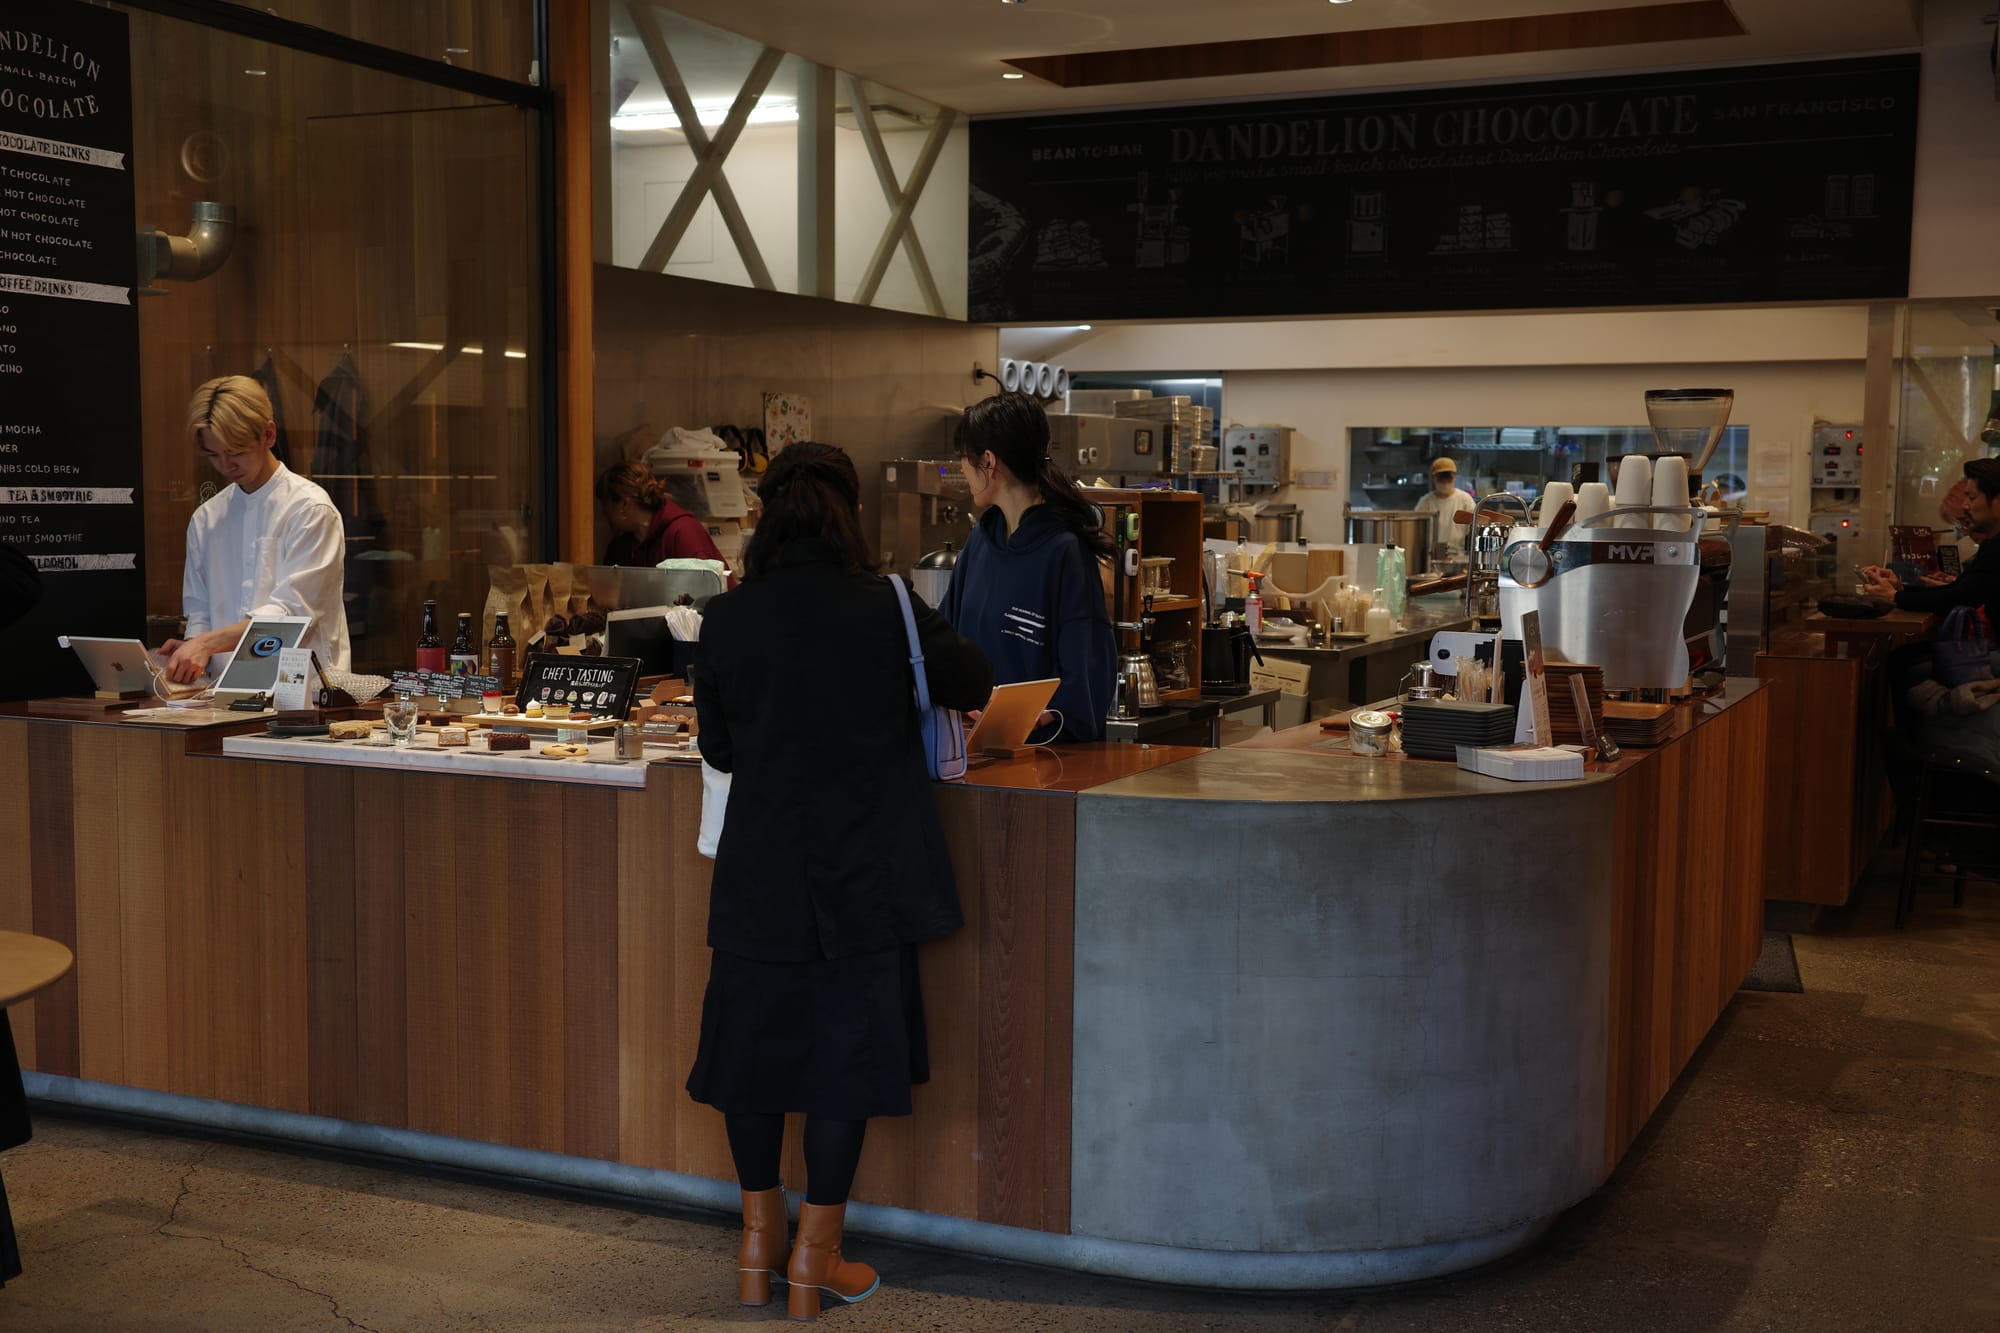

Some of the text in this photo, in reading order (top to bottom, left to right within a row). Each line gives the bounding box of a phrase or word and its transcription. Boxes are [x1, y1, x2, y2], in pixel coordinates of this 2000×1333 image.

[1170, 94, 1897, 164] DANDELION CHOCOLATE SAN FRANCISCO
[0, 134, 91, 161] OCOLATE DRINKS
[1031, 144, 1144, 162] BEAN-TO-BAR
[9, 168, 72, 187] CHOCOLATE
[4, 188, 87, 209] HOT CHOCOLATE
[20, 211, 80, 229] CHOCOLATE
[11, 231, 32, 243] HOT
[34, 234, 94, 250] CHOCOLATE
[34, 280, 73, 296] DRINKS
[5, 424, 42, 435] MOCHA
[0, 464, 81, 475] NIBS COLD BREW
[8, 489, 28, 502] TEA
[41, 489, 94, 502] SMOOTHIE
[21, 515, 41, 525] TEA
[2, 532, 86, 545] FRUIT SMOOTHIE
[1608, 544, 1654, 561] MVP
[542, 667, 615, 684] CHEF'S TASTING
